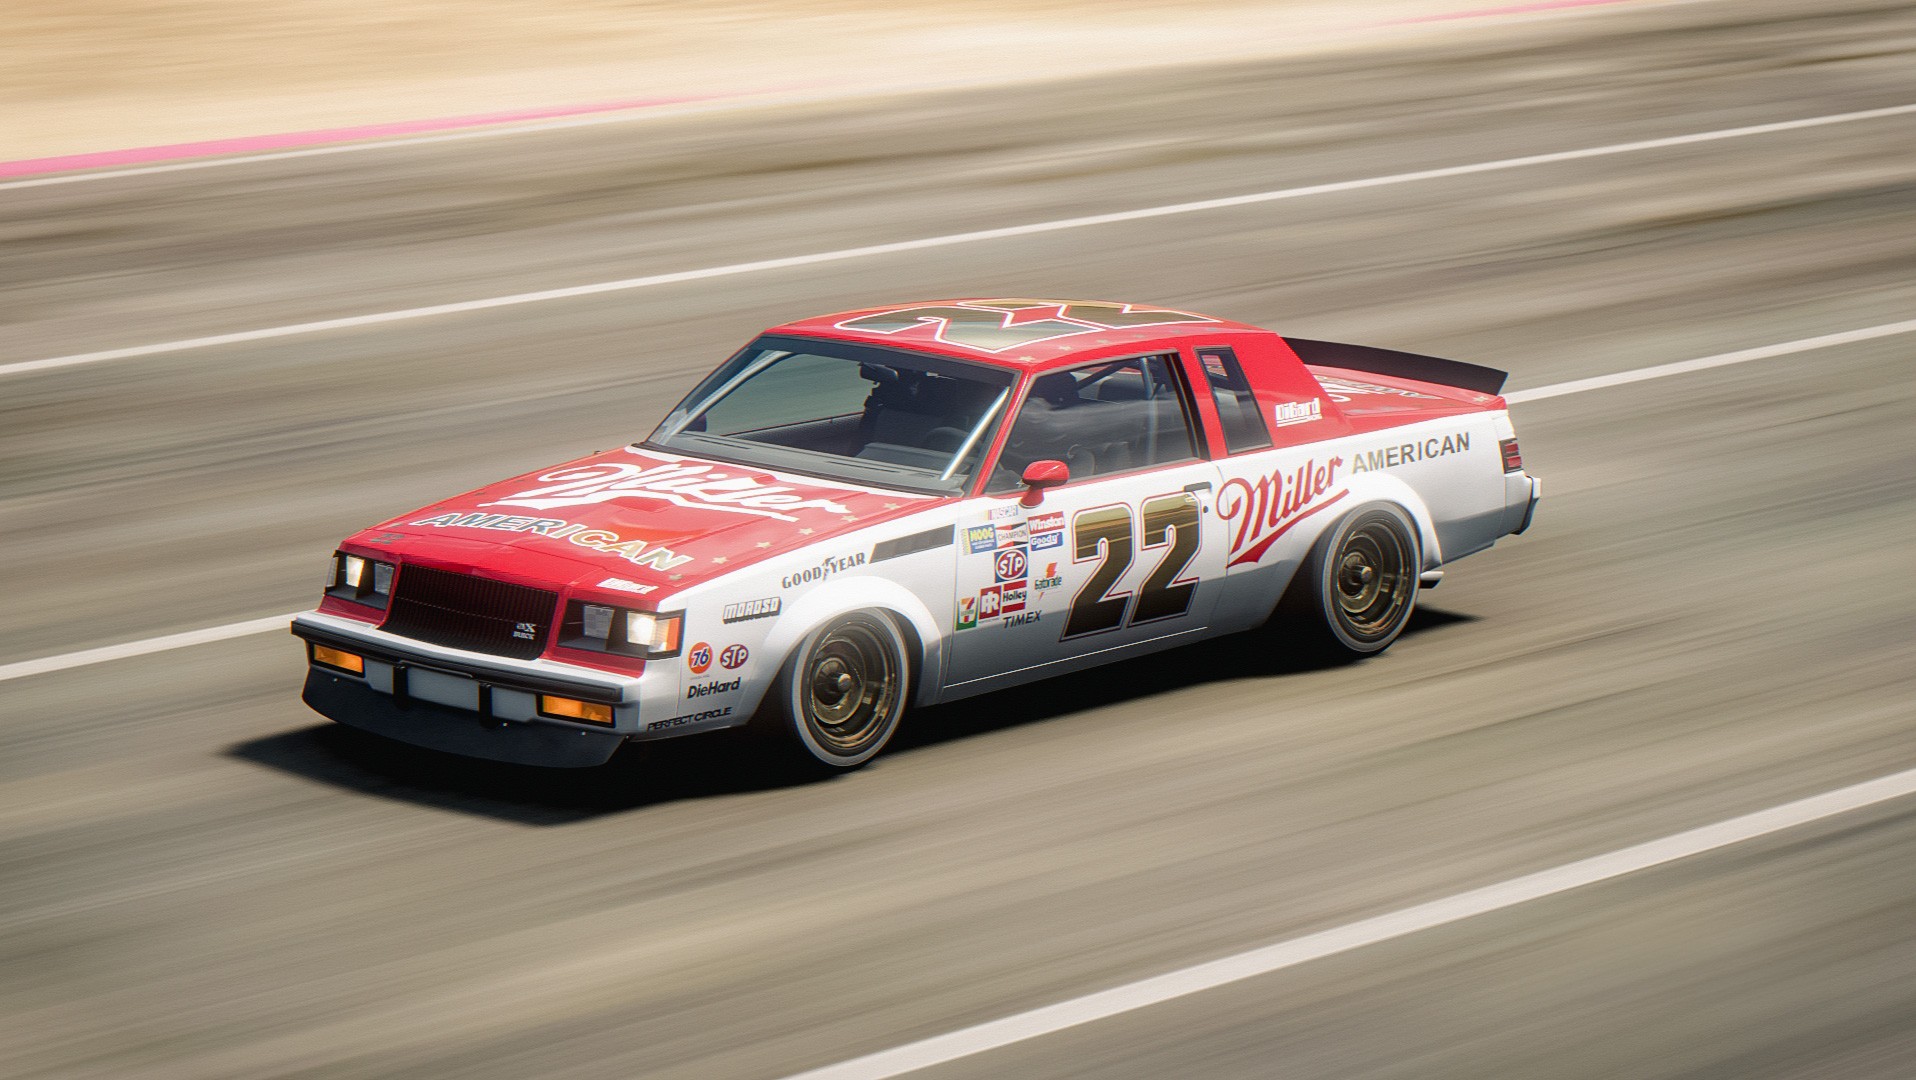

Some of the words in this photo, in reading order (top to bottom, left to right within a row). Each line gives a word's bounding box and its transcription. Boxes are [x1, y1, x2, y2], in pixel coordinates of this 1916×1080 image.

[1351, 431, 1470, 474] AMERICAN
[479, 460, 852, 521] Miller
[1216, 456, 1346, 562] Miller
[970, 527, 995, 541] MOOG
[998, 530, 1028, 541] CHAMPION
[1029, 516, 1064, 532] Winston
[409, 511, 694, 573] AMERICAN
[999, 552, 1023, 576] STP
[1059, 491, 1203, 642] 22
[1003, 590, 1028, 603] Holley
[723, 597, 782, 624] MOROSO
[1003, 610, 1042, 629] TIMEX
[691, 646, 710, 669] 76
[722, 645, 747, 668] STP
[687, 676, 742, 699] DieHard
[647, 713, 694, 732] PERFECT
[694, 706, 733, 722] CIRCLE
